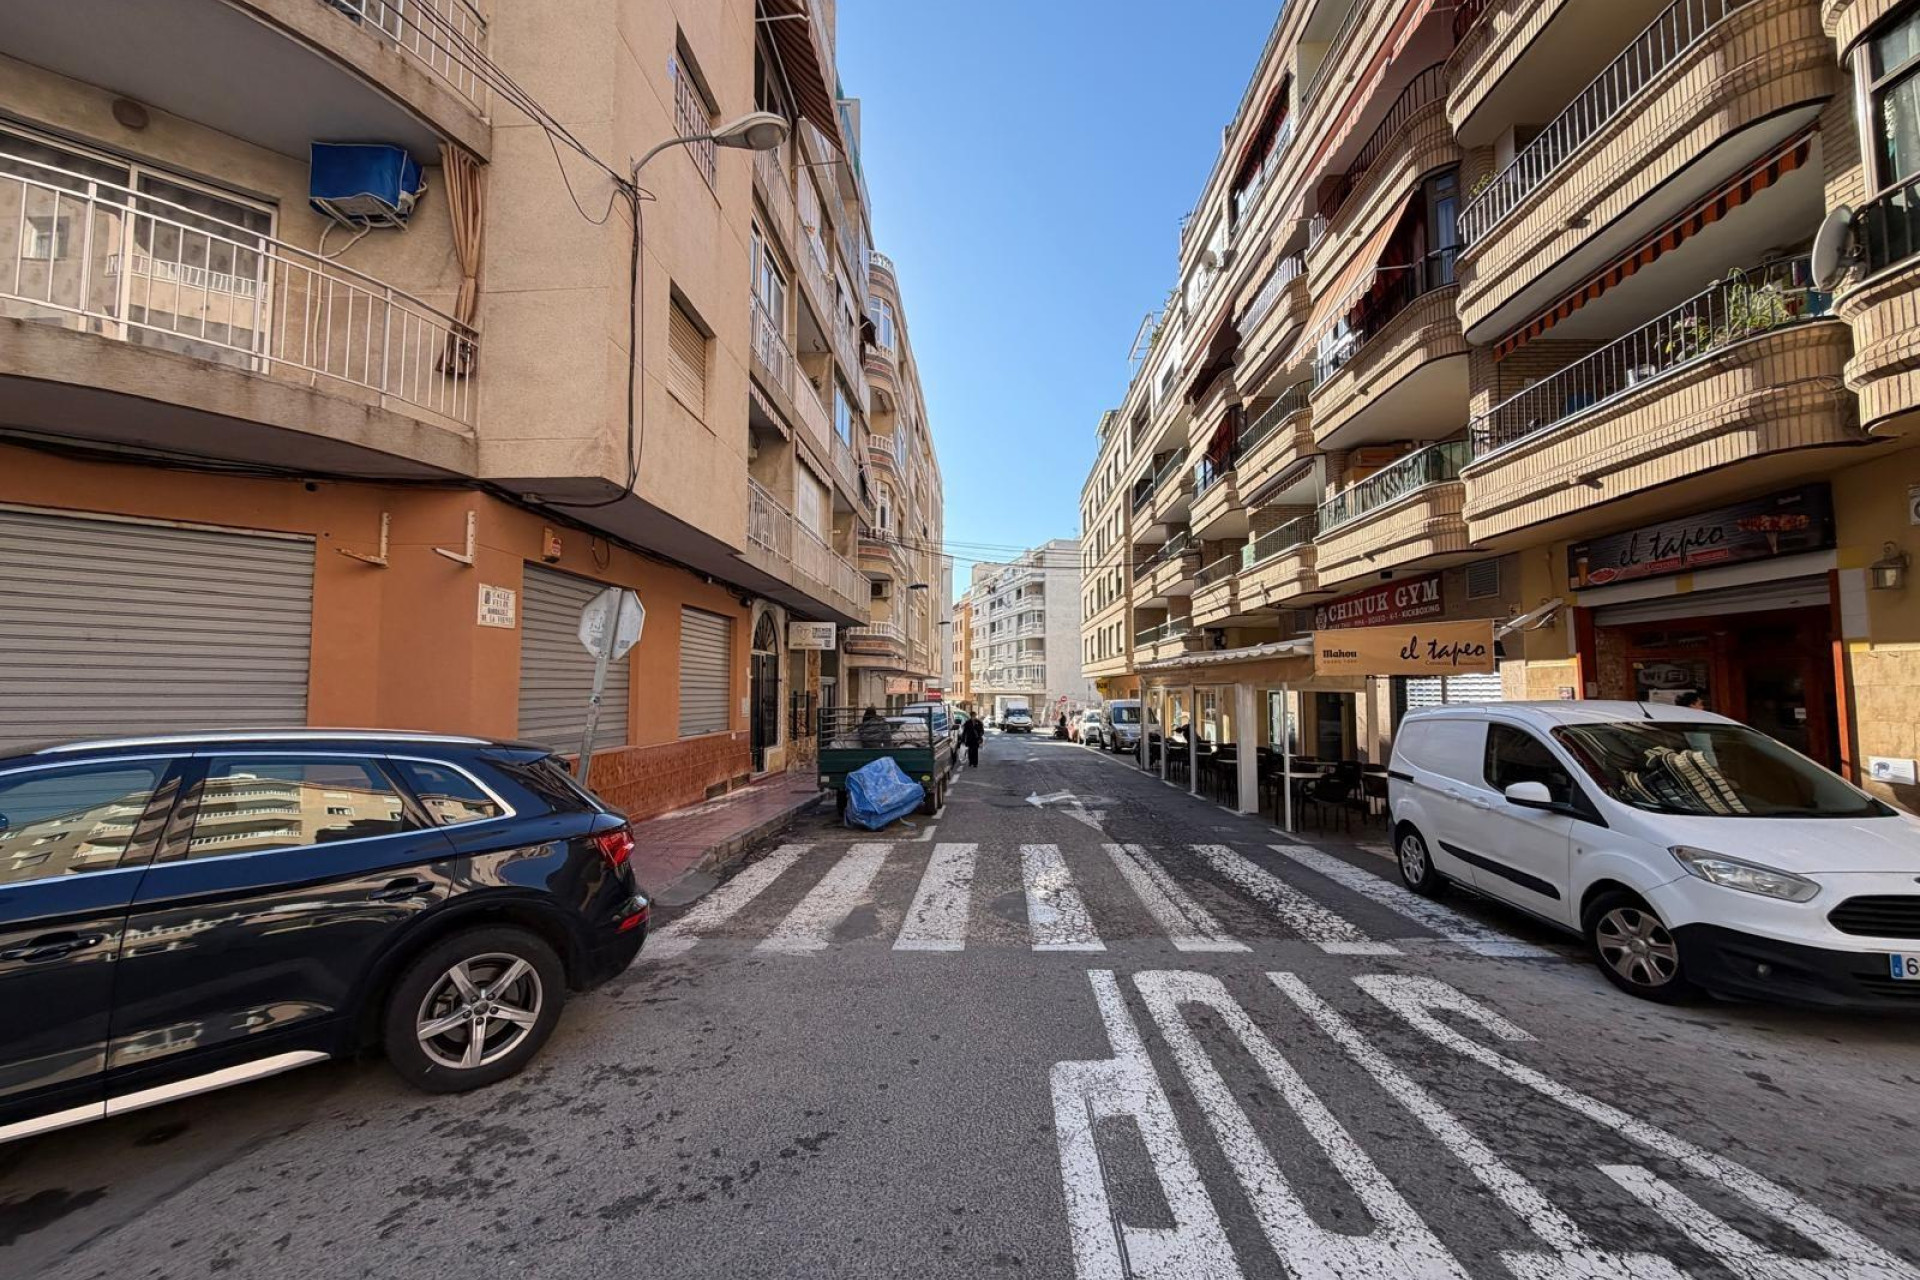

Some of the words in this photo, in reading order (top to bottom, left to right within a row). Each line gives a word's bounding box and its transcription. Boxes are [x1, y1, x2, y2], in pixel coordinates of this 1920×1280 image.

[1619, 532, 1641, 568] el
[1649, 525, 1725, 568] tapeo
[1329, 592, 1389, 622] CHINUK
[1396, 579, 1440, 608] GYM
[1402, 604, 1441, 618] KICKBOXING
[1323, 650, 1357, 658] Mahou
[1401, 636, 1420, 660] el
[1428, 639, 1486, 666] tapeo
